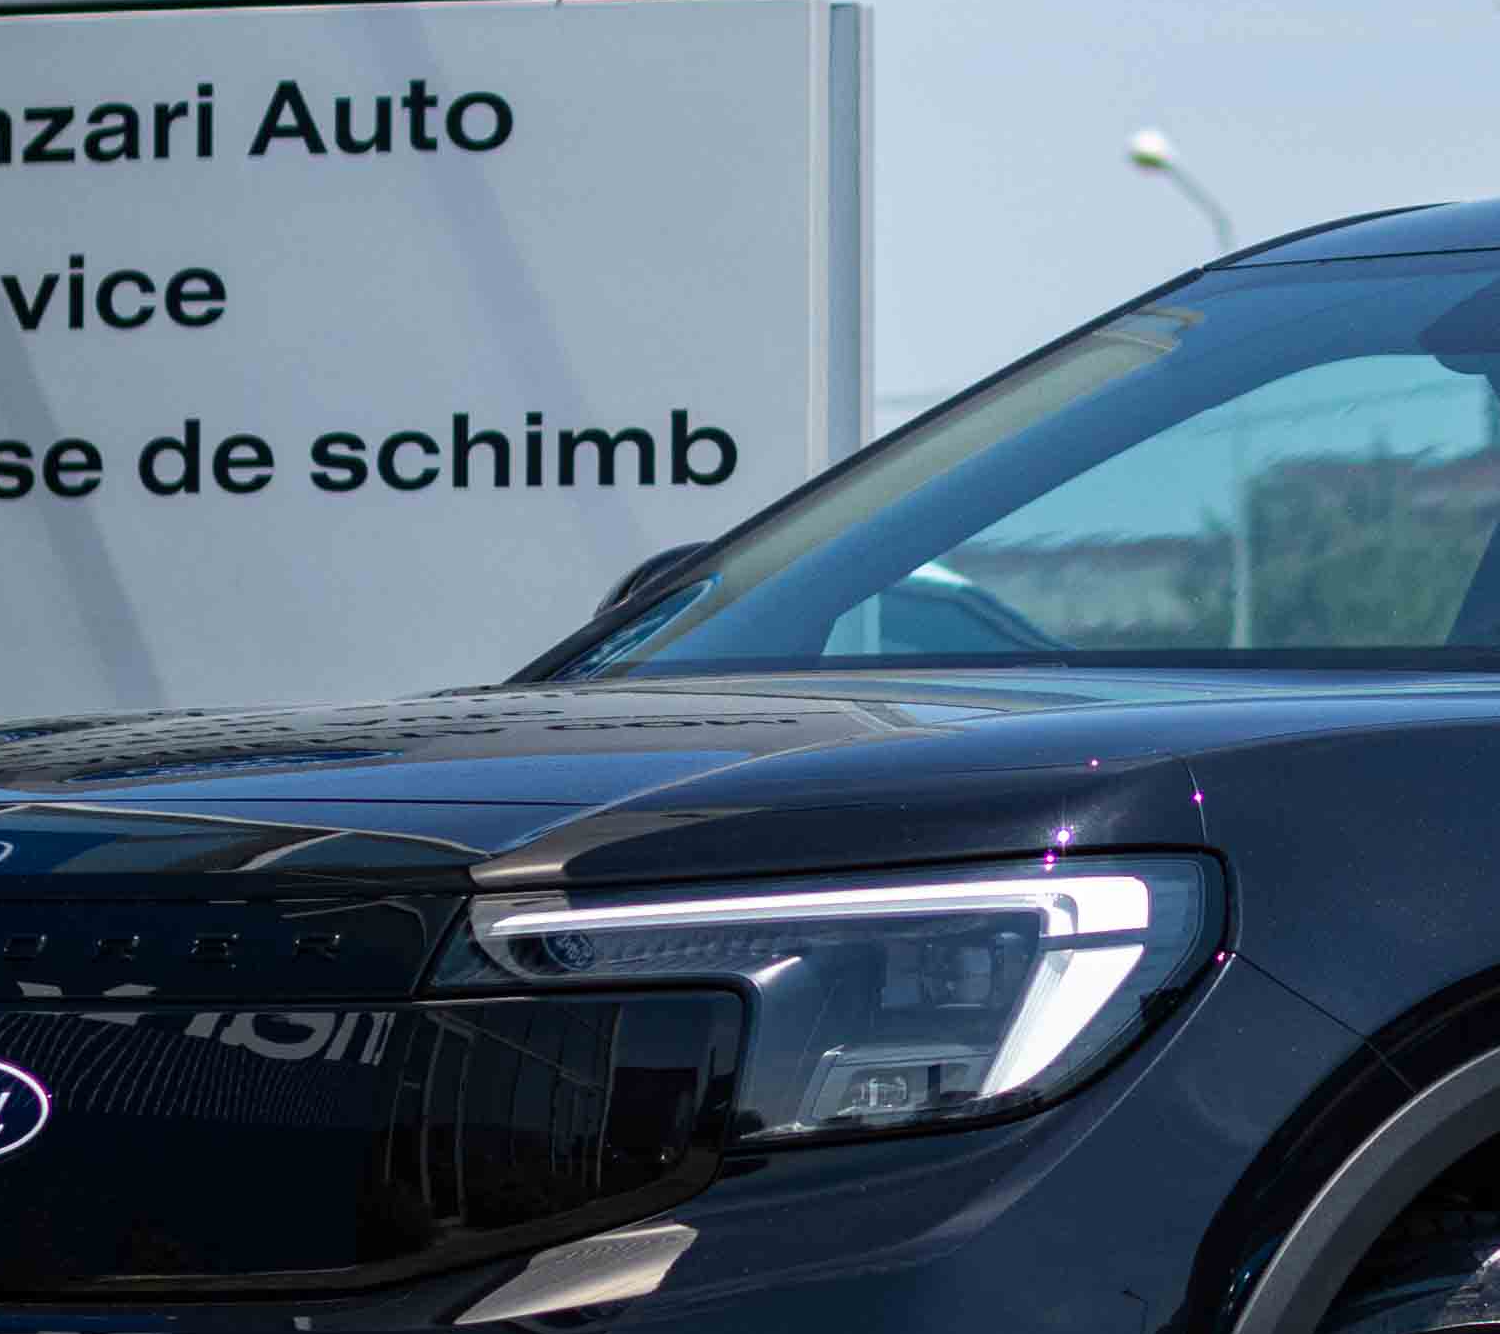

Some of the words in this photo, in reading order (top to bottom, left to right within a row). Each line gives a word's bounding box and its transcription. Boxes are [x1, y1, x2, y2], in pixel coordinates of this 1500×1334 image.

[247, 78, 515, 158] Auto
[137, 418, 276, 497] de
[308, 409, 739, 492] schimb
